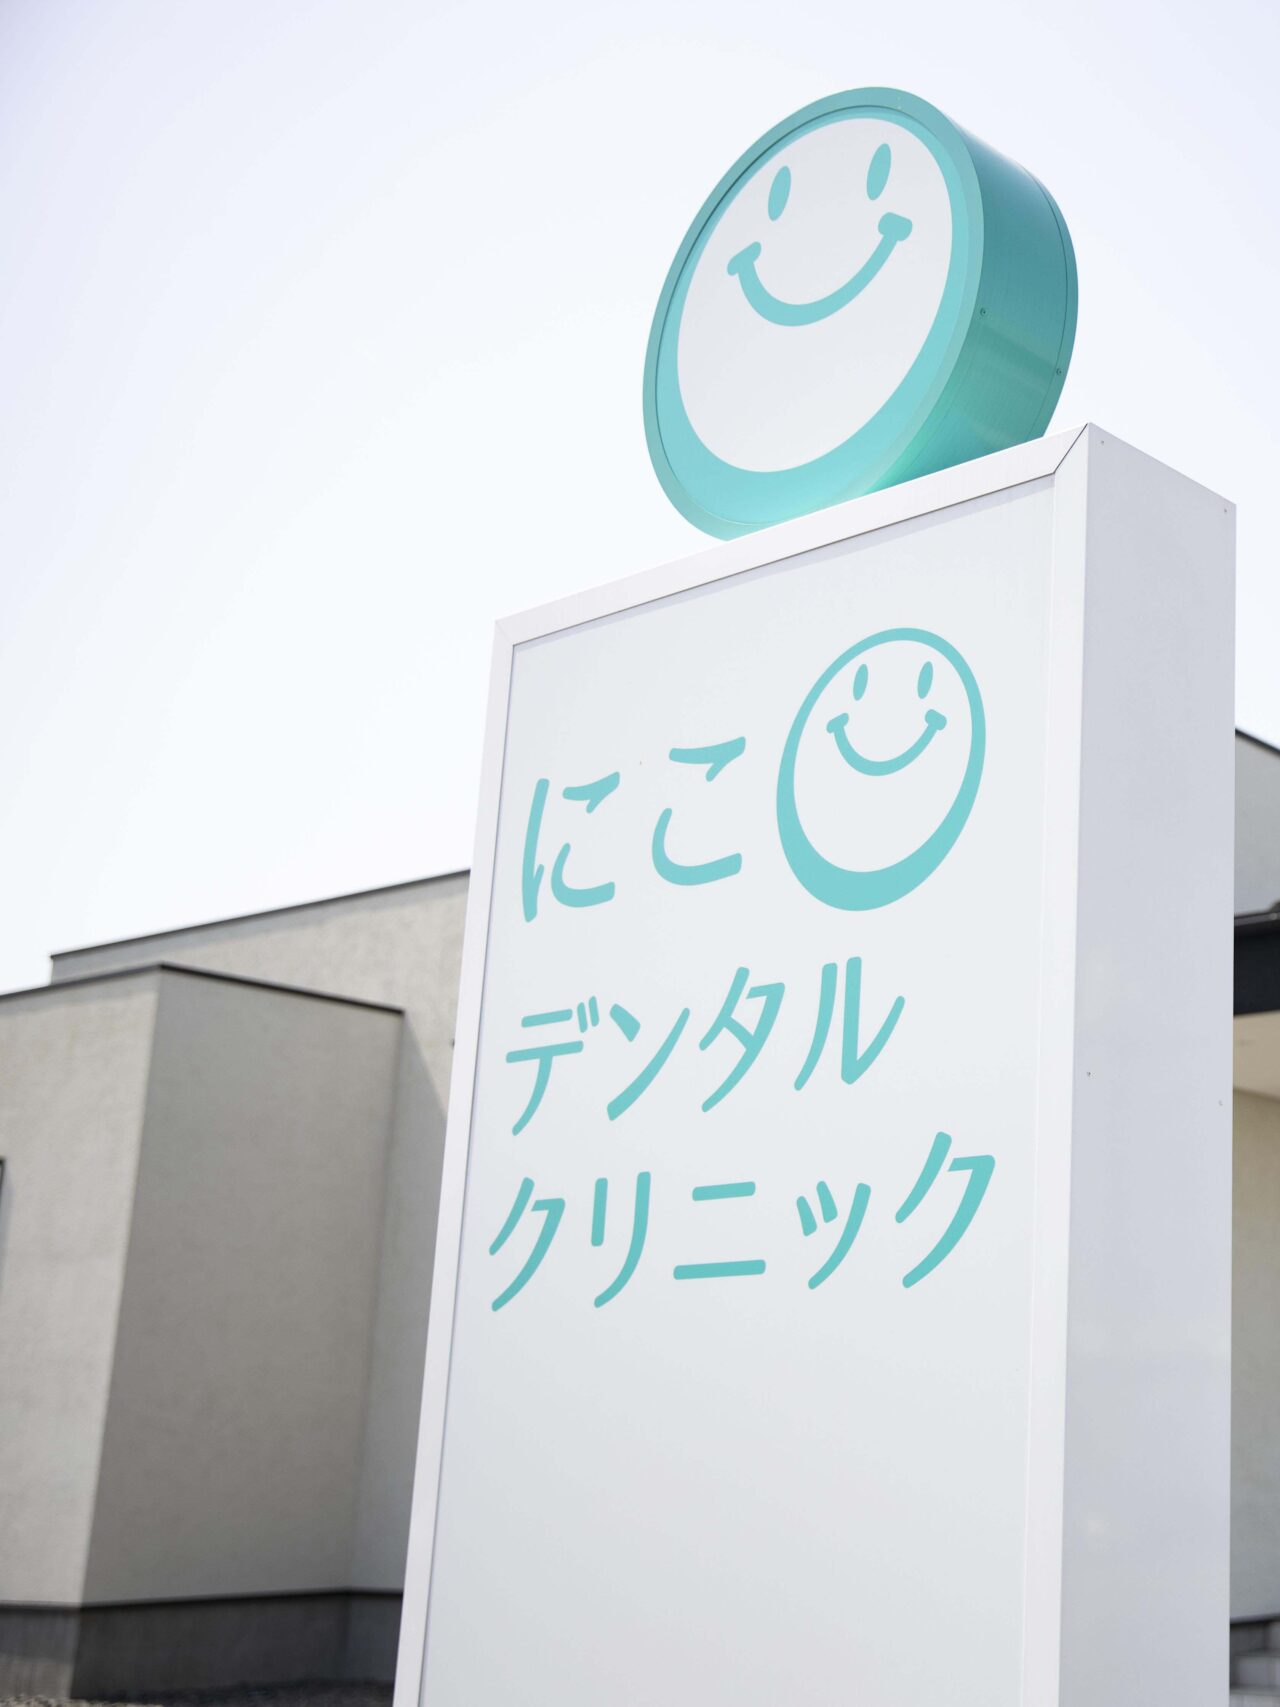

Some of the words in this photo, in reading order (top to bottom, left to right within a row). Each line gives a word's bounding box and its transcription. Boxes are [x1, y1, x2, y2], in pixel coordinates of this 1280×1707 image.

[522, 736, 746, 922] にこ
[506, 956, 905, 1136] デンタル
[489, 1131, 996, 1312] クリニック
